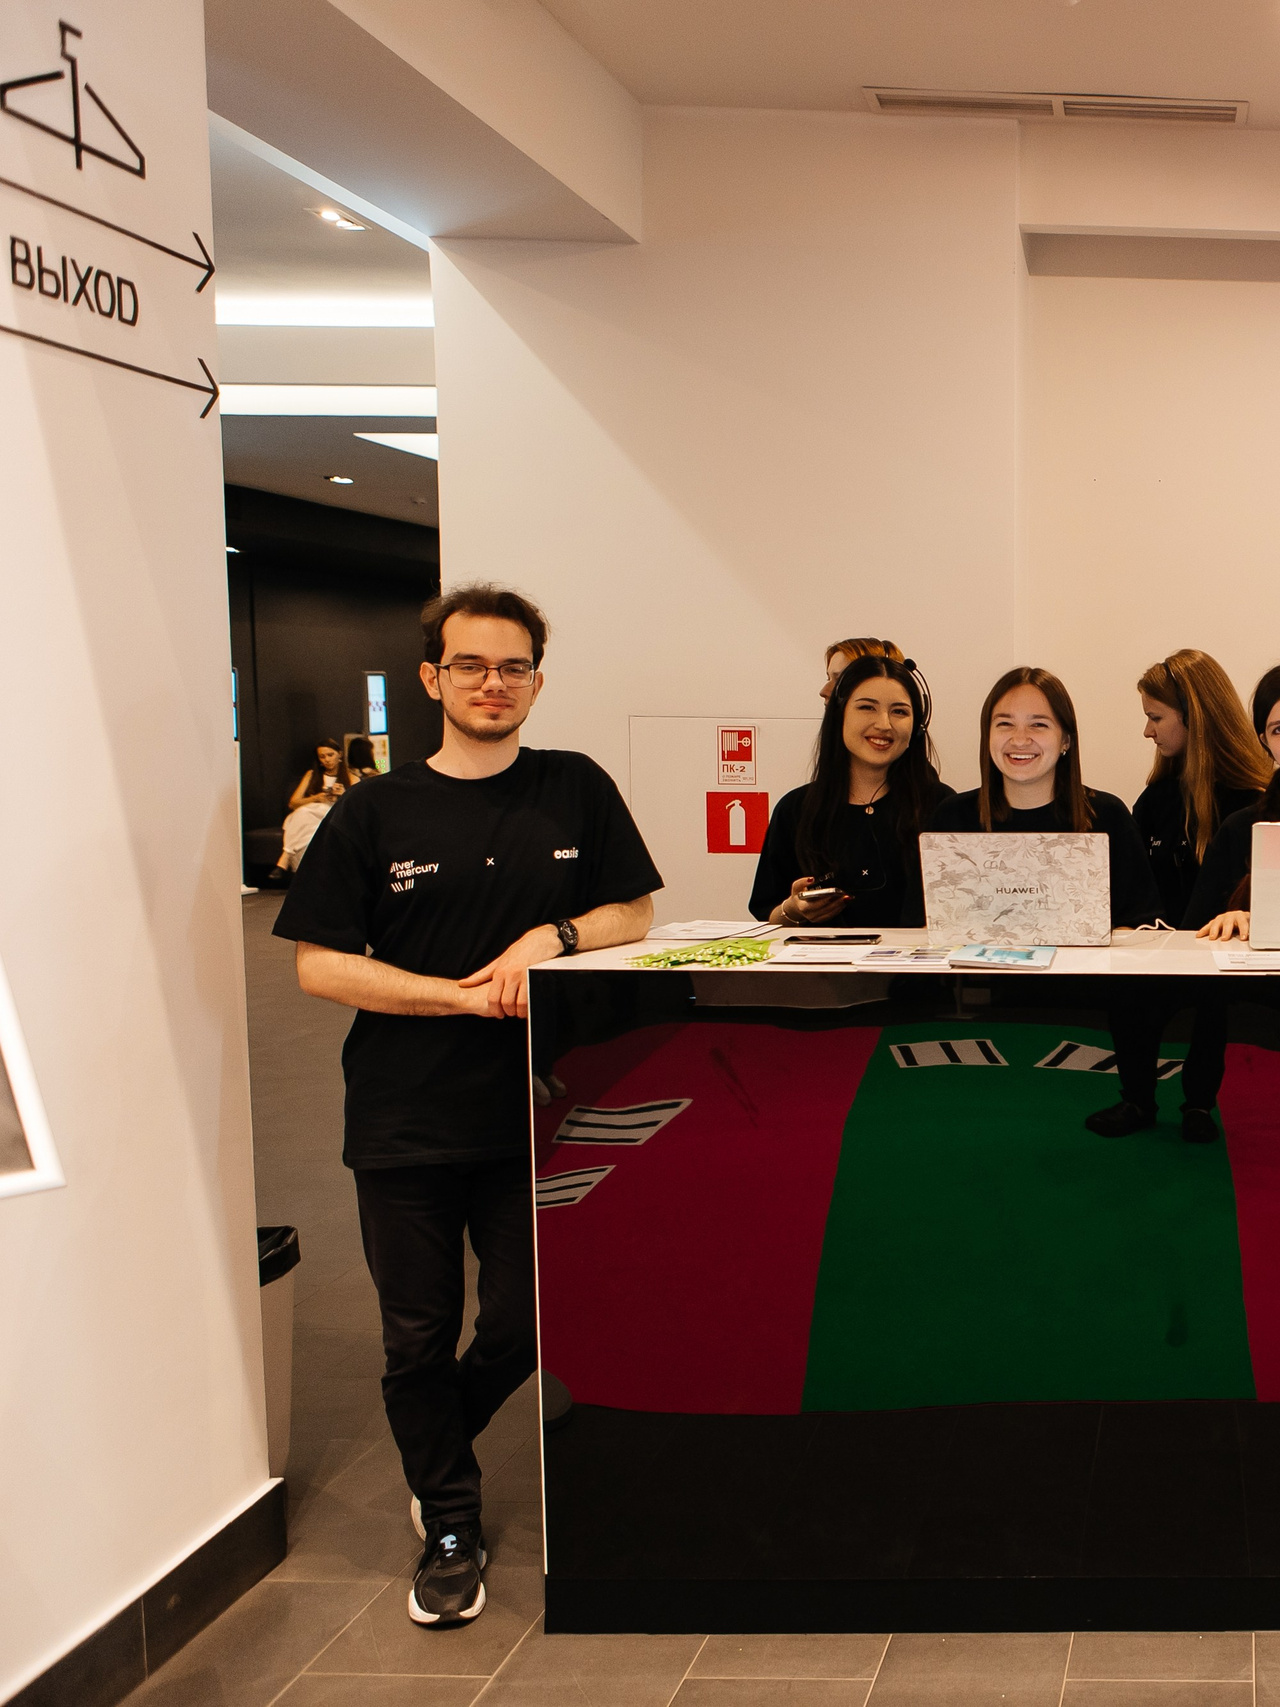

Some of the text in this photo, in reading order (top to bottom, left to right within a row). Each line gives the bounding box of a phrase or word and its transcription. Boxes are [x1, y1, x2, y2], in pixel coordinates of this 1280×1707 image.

[10, 235, 139, 327] ВЫХОД
[722, 764, 746, 773] ПК-2
[396, 863, 439, 879] mercury
[996, 887, 1039, 895] HUAWEI
